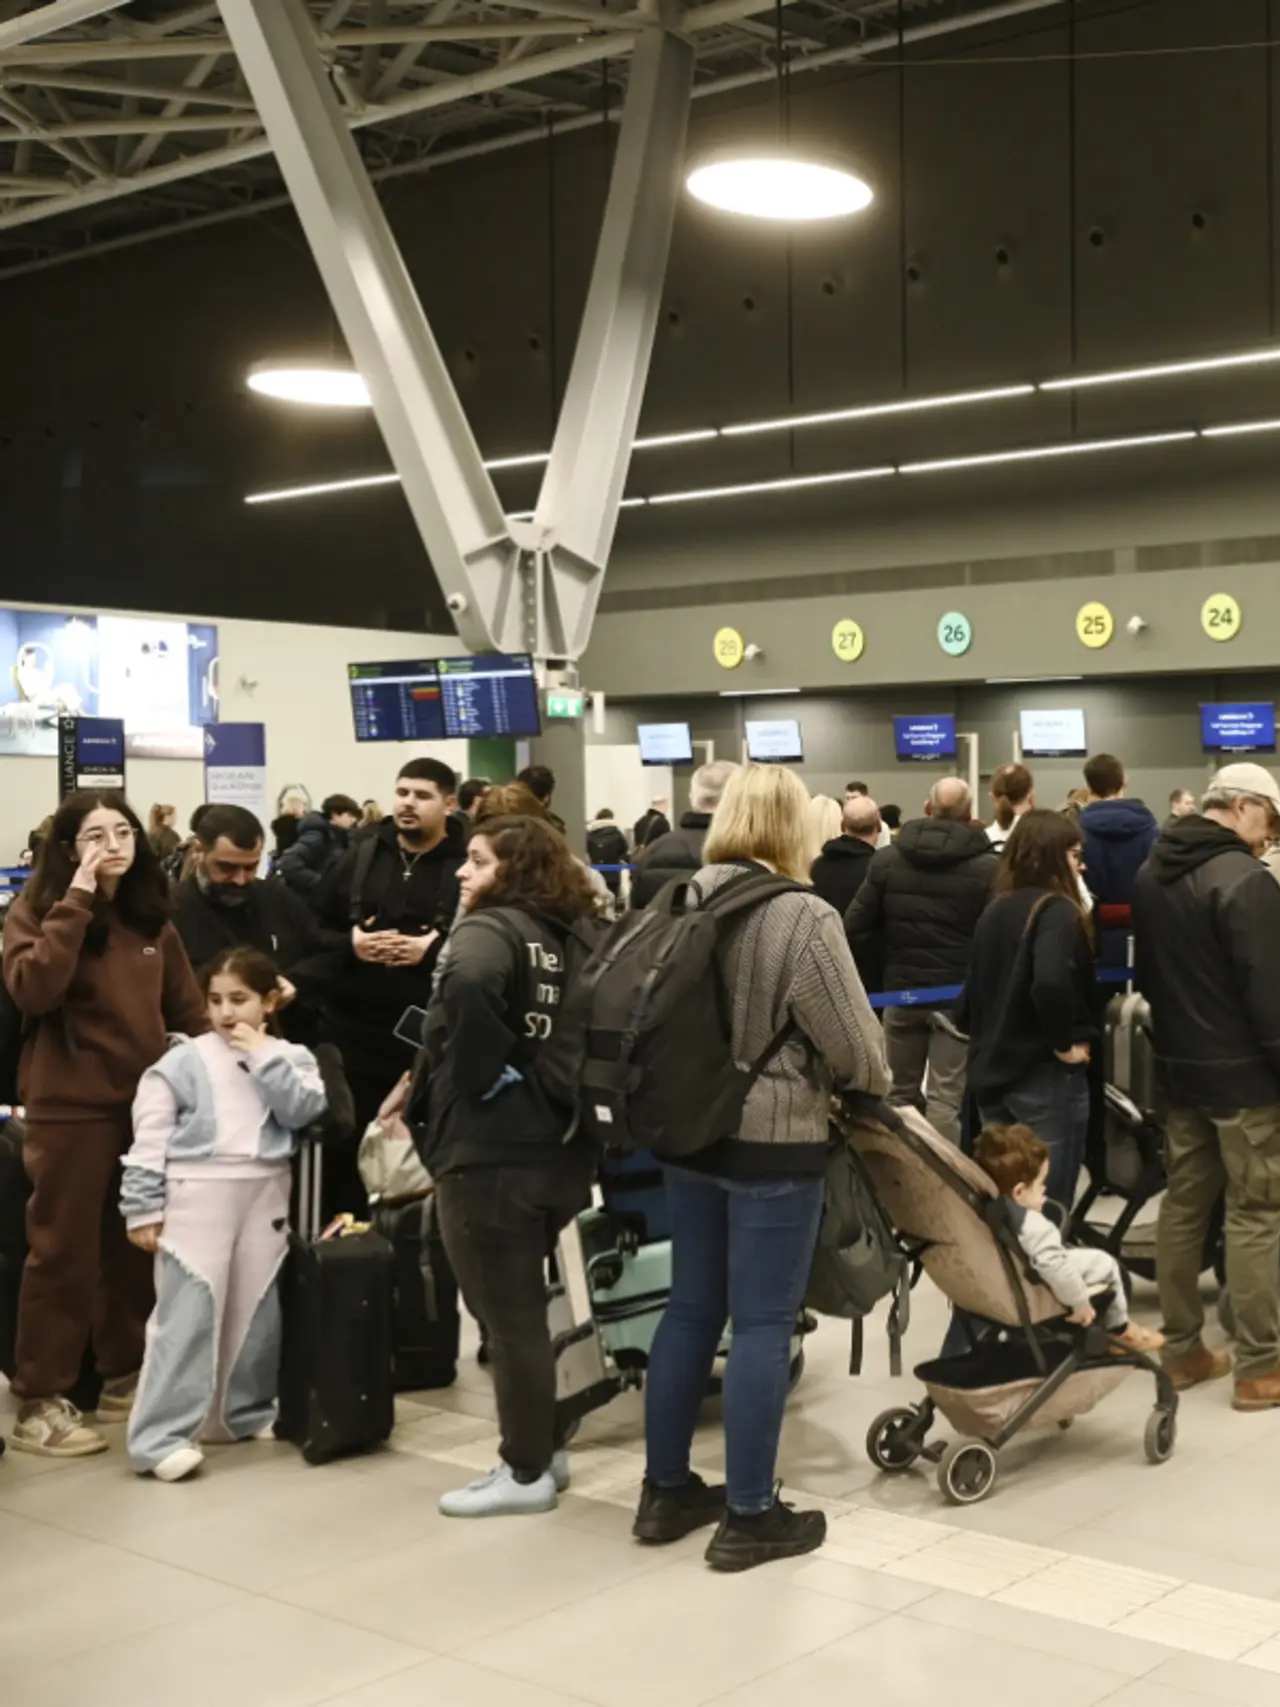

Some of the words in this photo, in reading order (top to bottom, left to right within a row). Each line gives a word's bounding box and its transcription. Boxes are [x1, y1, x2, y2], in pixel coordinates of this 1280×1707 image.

[1083, 615, 1106, 635] 25
[1208, 607, 1233, 627] 24
[838, 631, 857, 650] 27
[943, 624, 966, 644] 26
[720, 640, 738, 656] 28
[63, 736, 76, 794] LLIANCE
